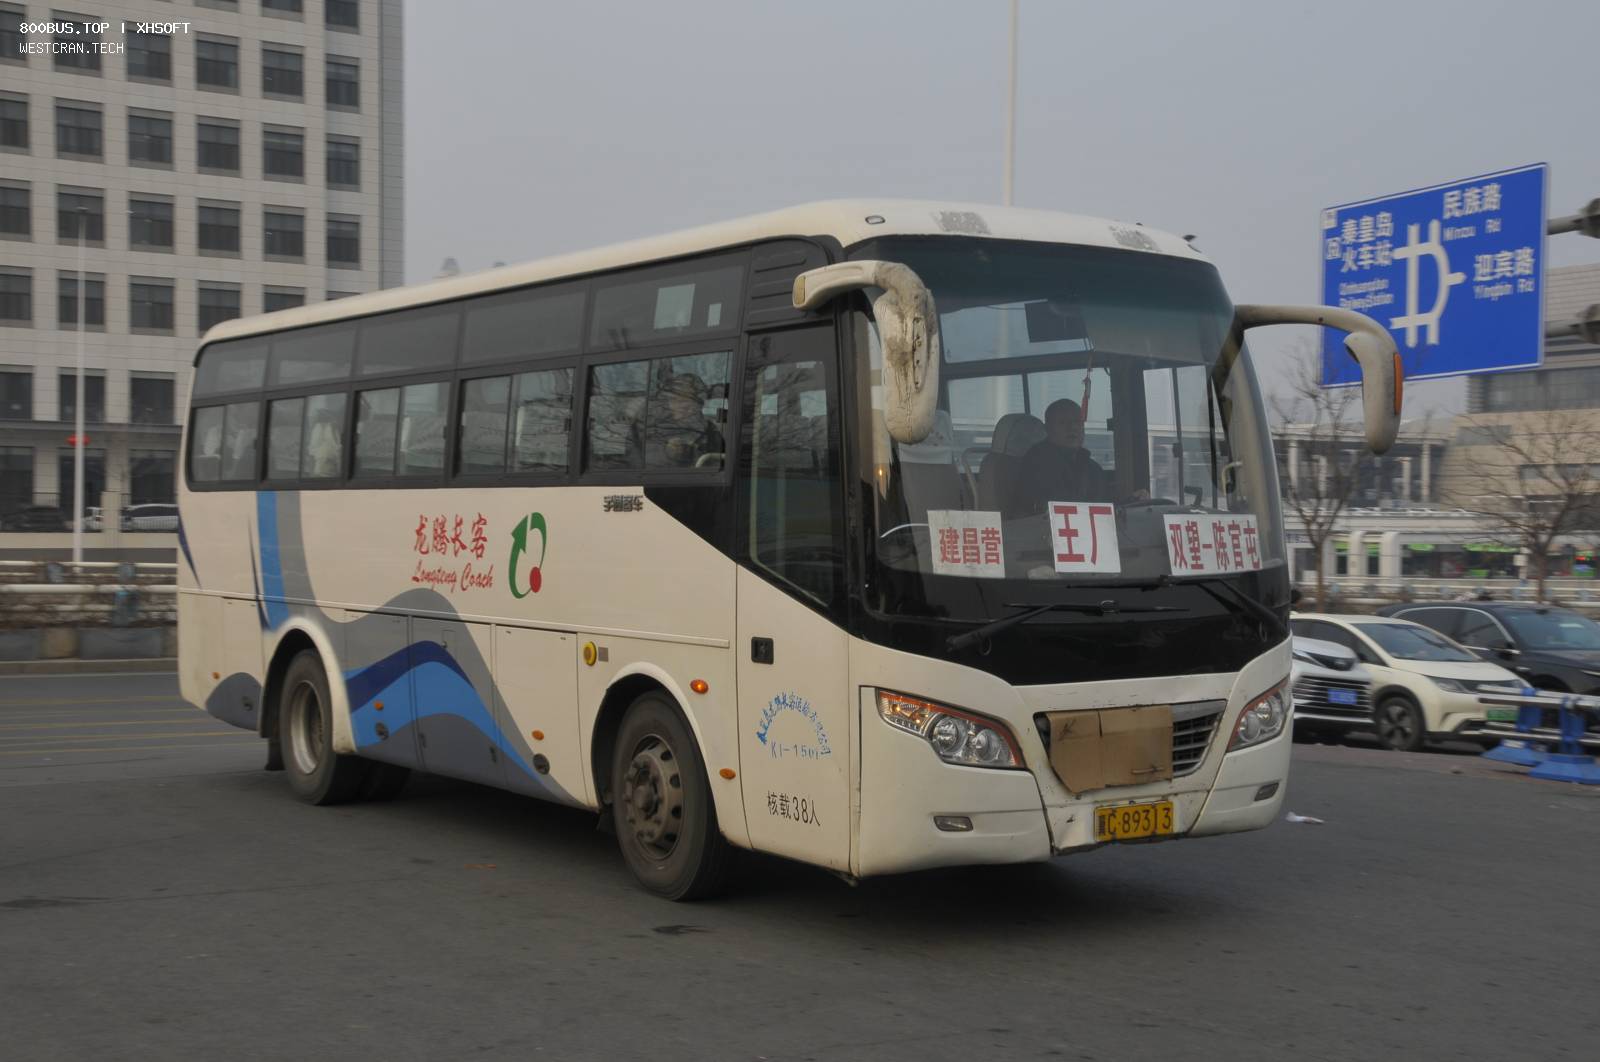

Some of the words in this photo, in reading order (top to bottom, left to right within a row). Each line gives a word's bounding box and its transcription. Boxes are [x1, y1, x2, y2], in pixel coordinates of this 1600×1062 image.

[1443, 183, 1502, 219] 民族路
[1341, 211, 1394, 245] 秦皇岛
[1340, 240, 1394, 273] 火车站
[1473, 246, 1535, 281] 迎宾路
[414, 512, 488, 560] 龙腾长客
[939, 527, 1001, 564] 建昌营
[1053, 505, 1112, 565] 王厂
[461, 562, 493, 591] Coach
[767, 790, 821, 826] 核载38人
